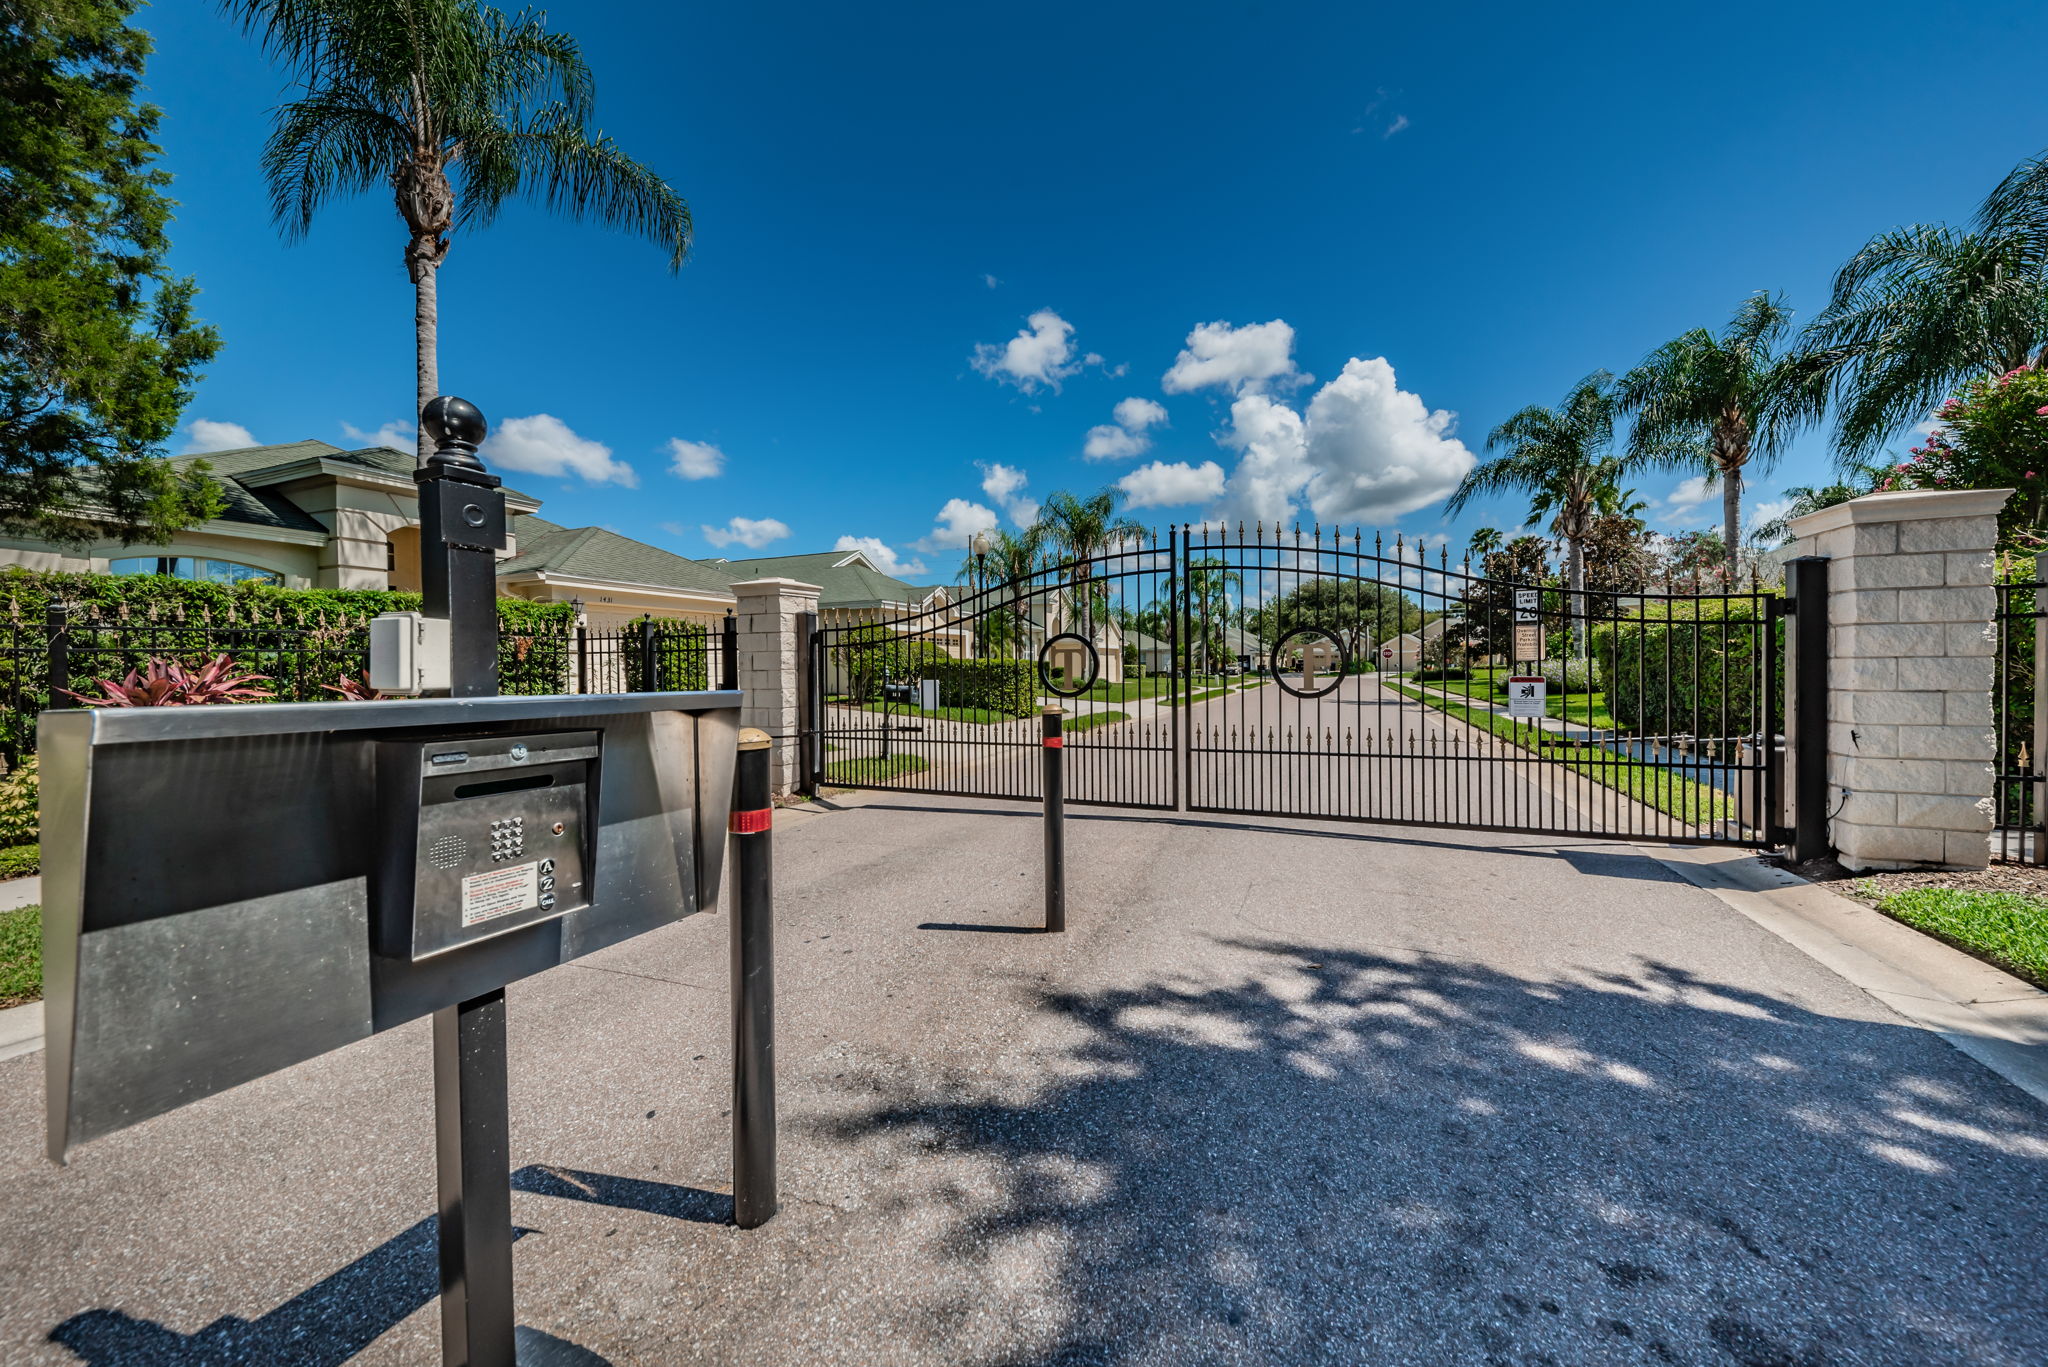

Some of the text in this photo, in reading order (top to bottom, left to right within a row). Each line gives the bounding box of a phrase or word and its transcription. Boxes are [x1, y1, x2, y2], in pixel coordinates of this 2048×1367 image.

[542, 861, 553, 873] A
[543, 878, 553, 890] Z
[541, 898, 555, 906] CALL
